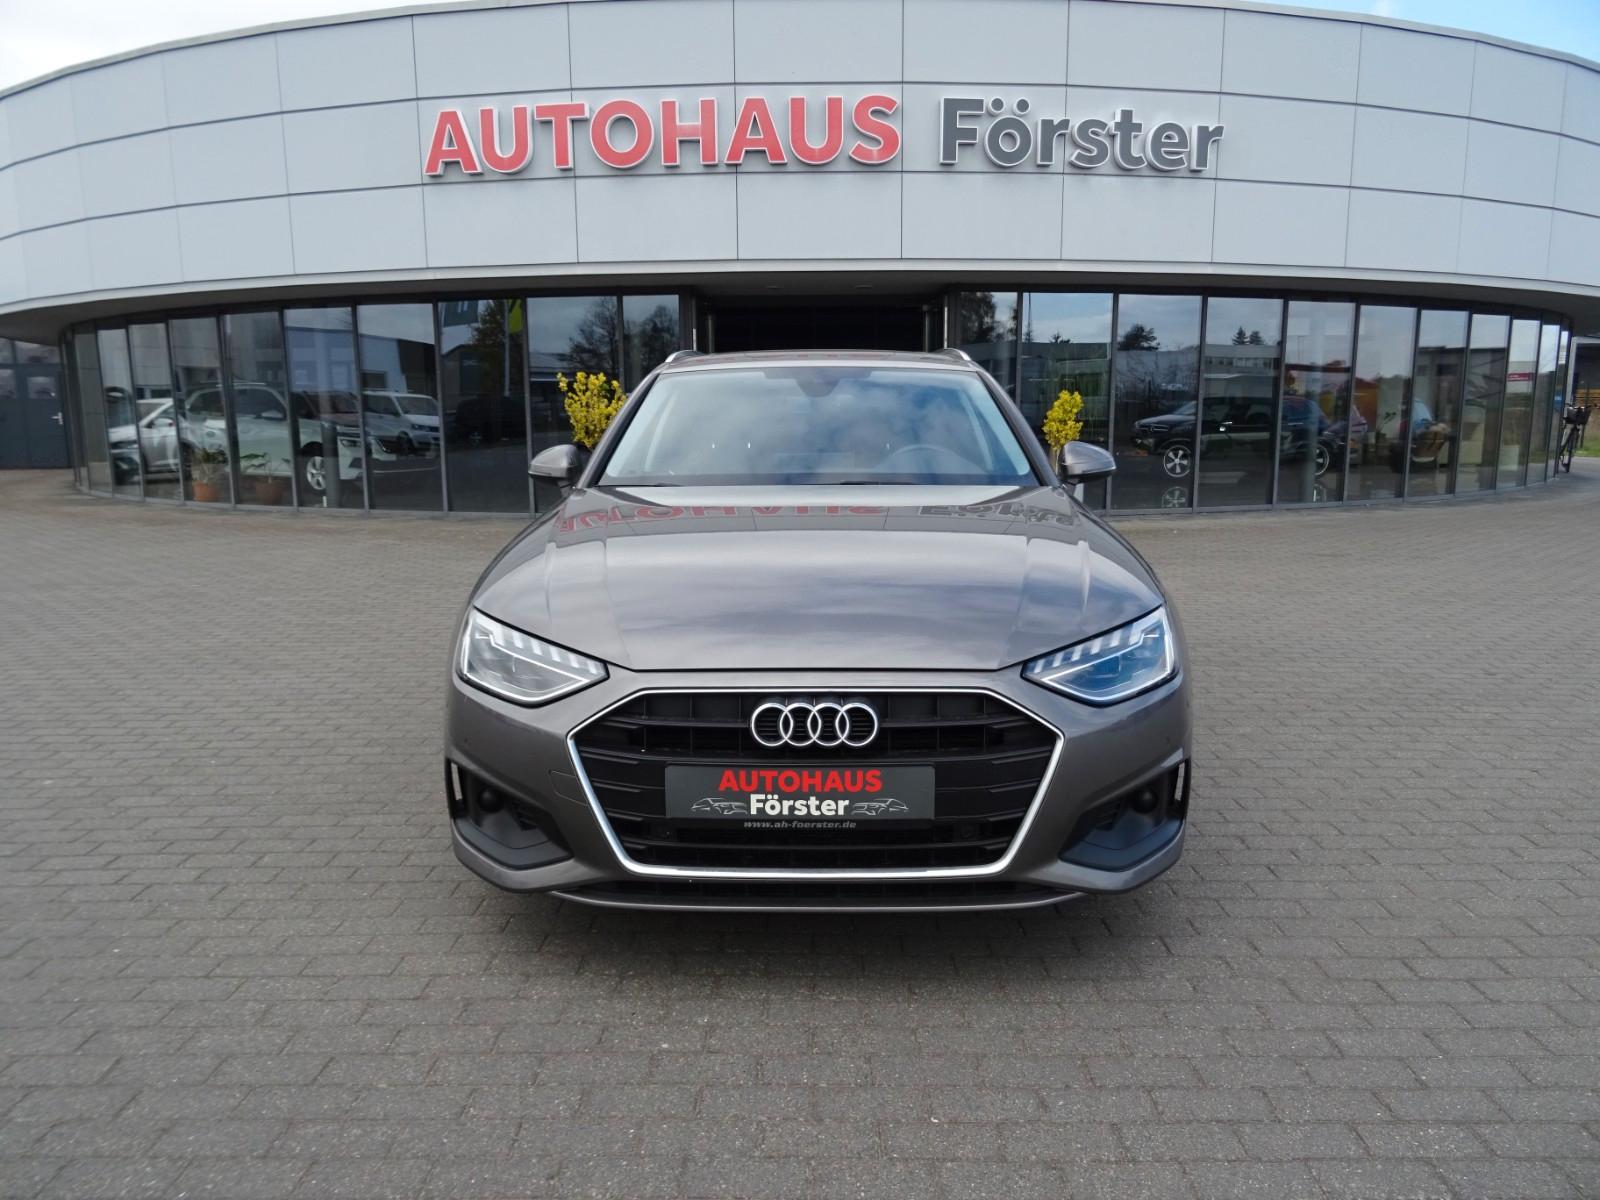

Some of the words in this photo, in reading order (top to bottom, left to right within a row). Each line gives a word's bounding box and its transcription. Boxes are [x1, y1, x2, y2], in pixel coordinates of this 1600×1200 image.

[424, 95, 901, 176] AUTOHAUS
[939, 96, 1225, 172] Förster
[718, 769, 882, 793] AUTOHAUS
[749, 793, 850, 816] Förster
[743, 820, 857, 830] www.ah-foerster.de
